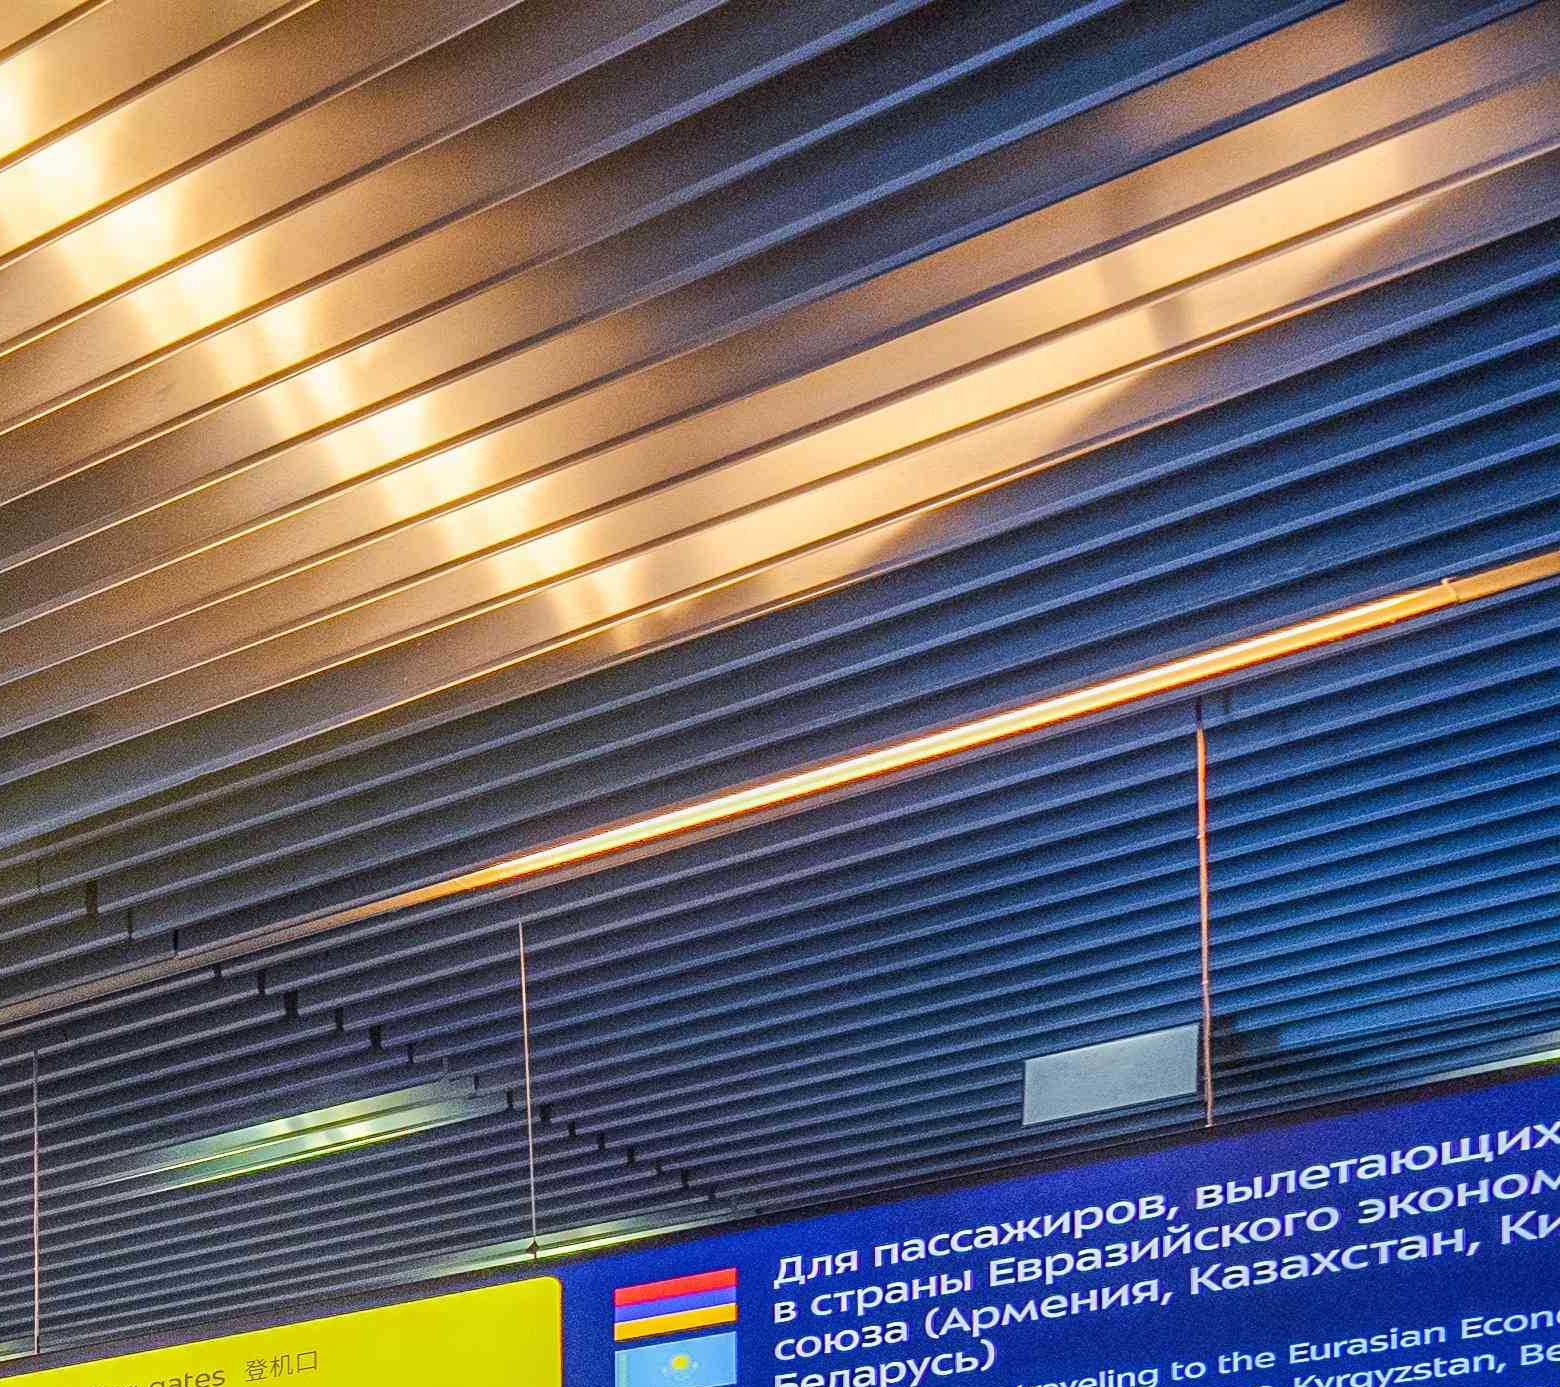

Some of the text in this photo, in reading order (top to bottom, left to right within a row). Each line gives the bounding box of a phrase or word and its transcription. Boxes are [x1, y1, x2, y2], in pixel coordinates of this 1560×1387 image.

[773, 1120, 1560, 1289] Для пассажиров, вылетающих
[773, 1299, 797, 1324] в
[811, 1269, 973, 1316] страны
[989, 1206, 1339, 1288] Евразийского
[774, 1320, 909, 1361] союза
[925, 1278, 1174, 1340] (Армения,
[1191, 1228, 1480, 1295] Казахстан,
[244, 1349, 319, 1383] 登机口
[1171, 1360, 1207, 1381] to
[1218, 1350, 1276, 1374] the
[1289, 1324, 1446, 1364] Eurasian
[1461, 1310, 1560, 1340] Econ
